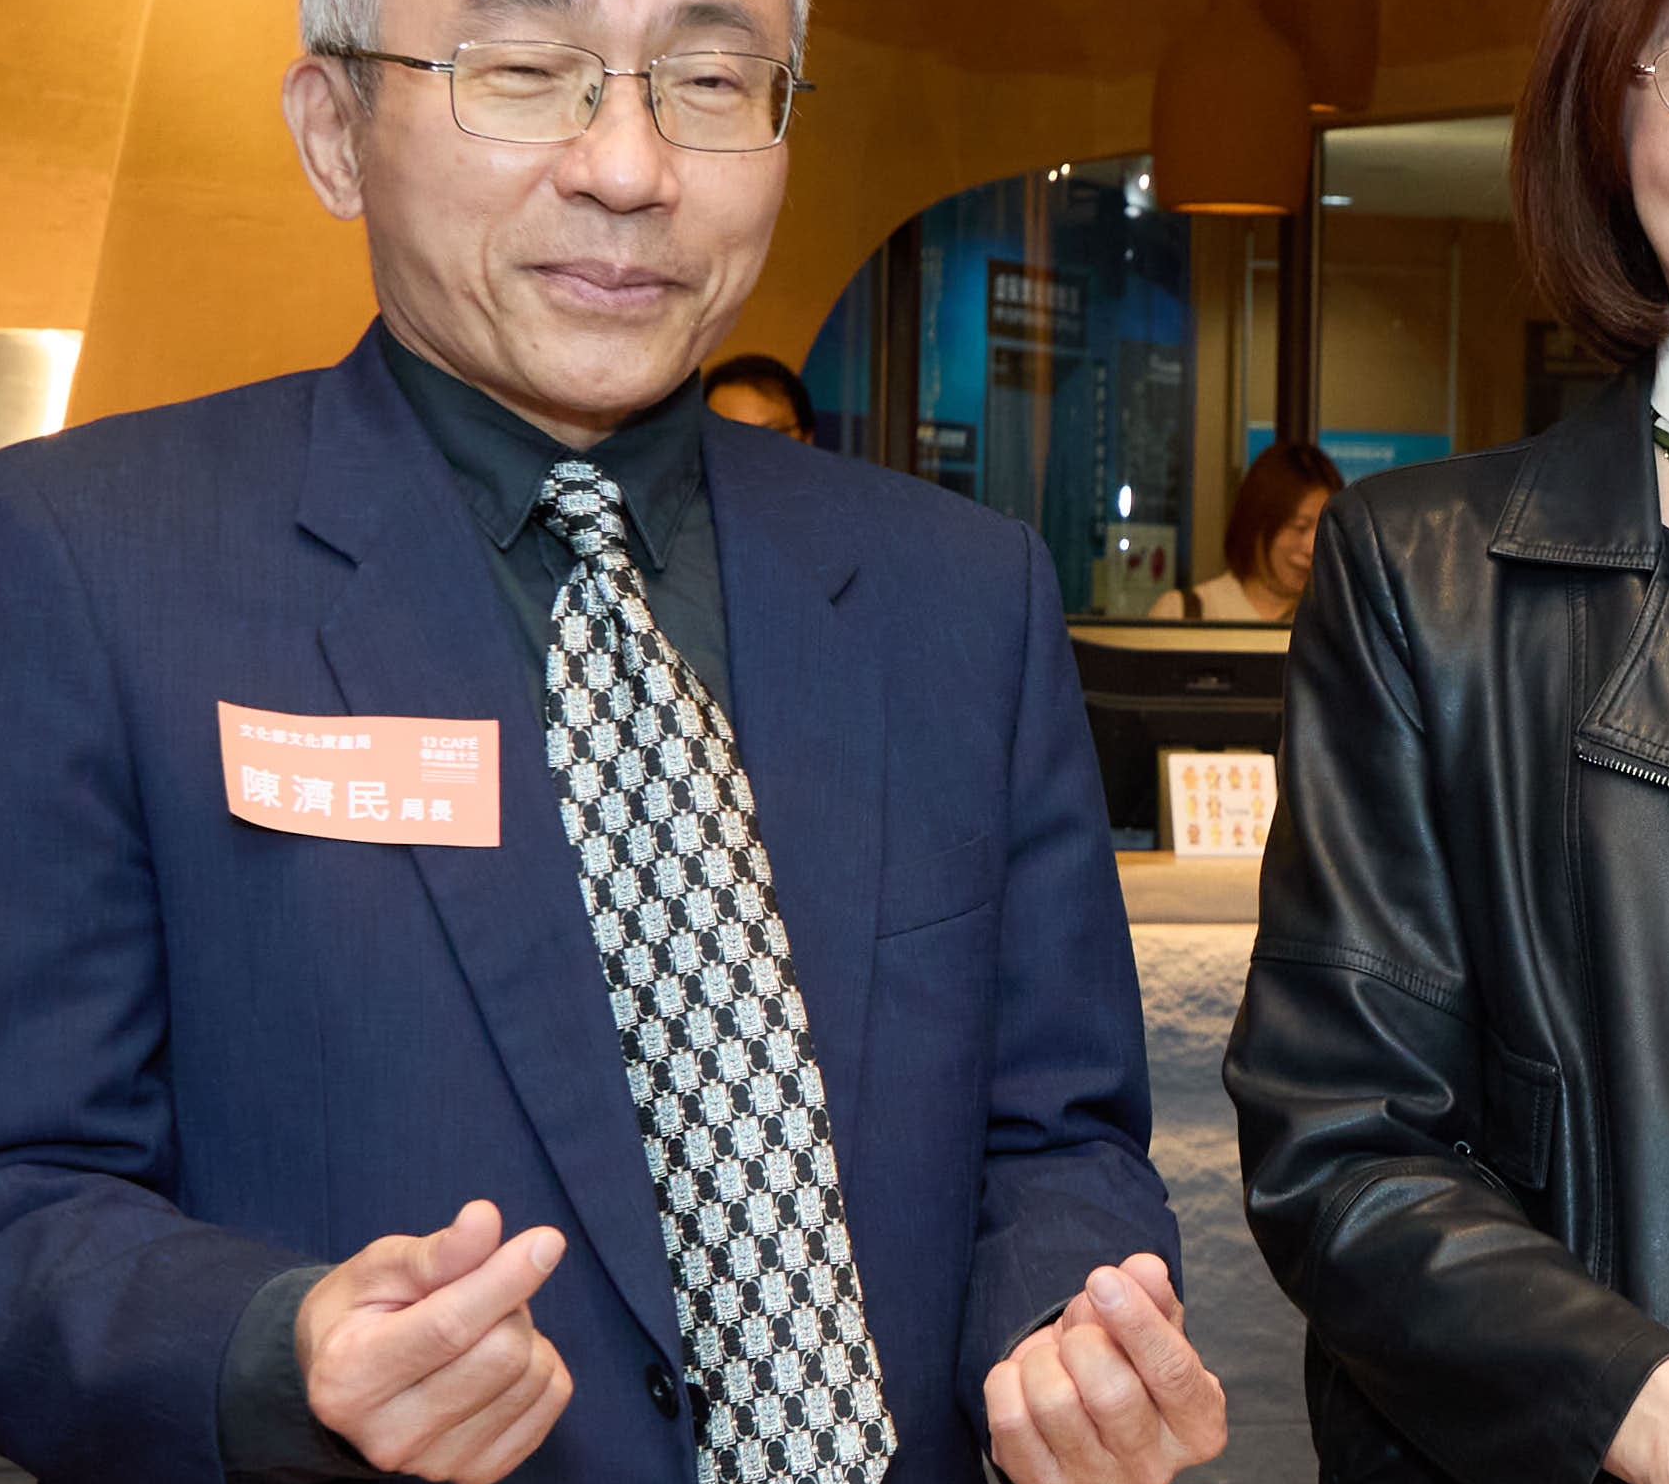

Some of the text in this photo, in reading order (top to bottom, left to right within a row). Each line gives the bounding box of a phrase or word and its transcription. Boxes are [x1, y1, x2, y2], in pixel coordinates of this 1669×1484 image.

[240, 764, 391, 822] 陳濟民
[400, 797, 454, 822] 局長
